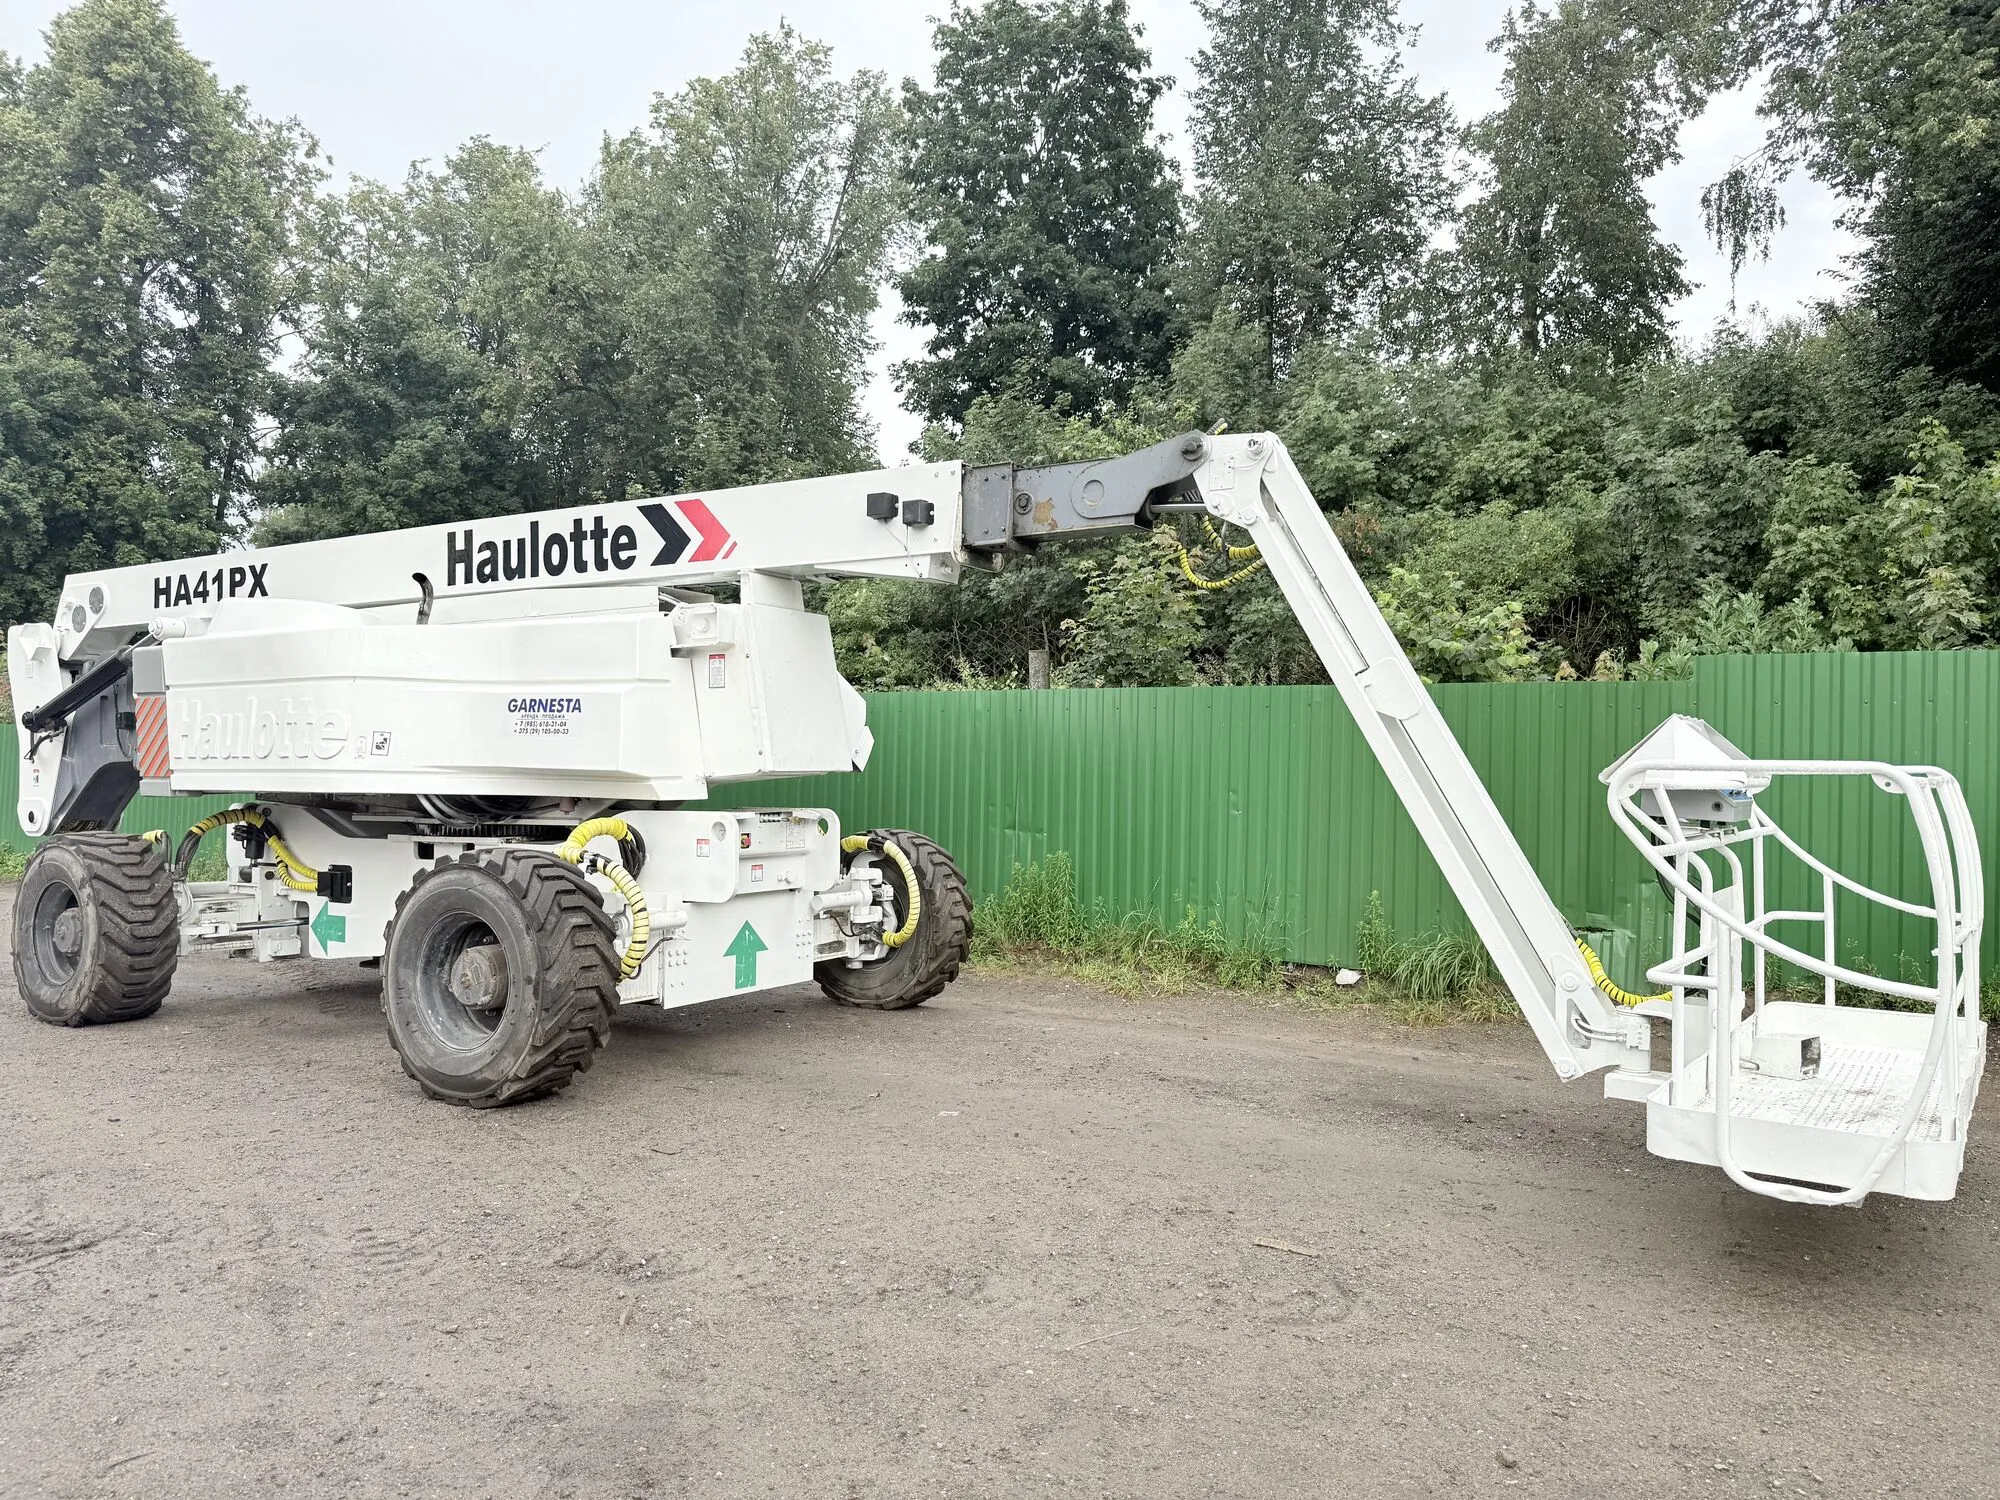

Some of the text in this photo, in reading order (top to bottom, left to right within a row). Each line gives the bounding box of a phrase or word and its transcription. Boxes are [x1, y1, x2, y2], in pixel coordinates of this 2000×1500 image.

[446, 515, 638, 586] Haulotte
[154, 563, 269, 609] HA41PX
[173, 696, 350, 760] Haulotte
[507, 698, 582, 713] GARNESTA
